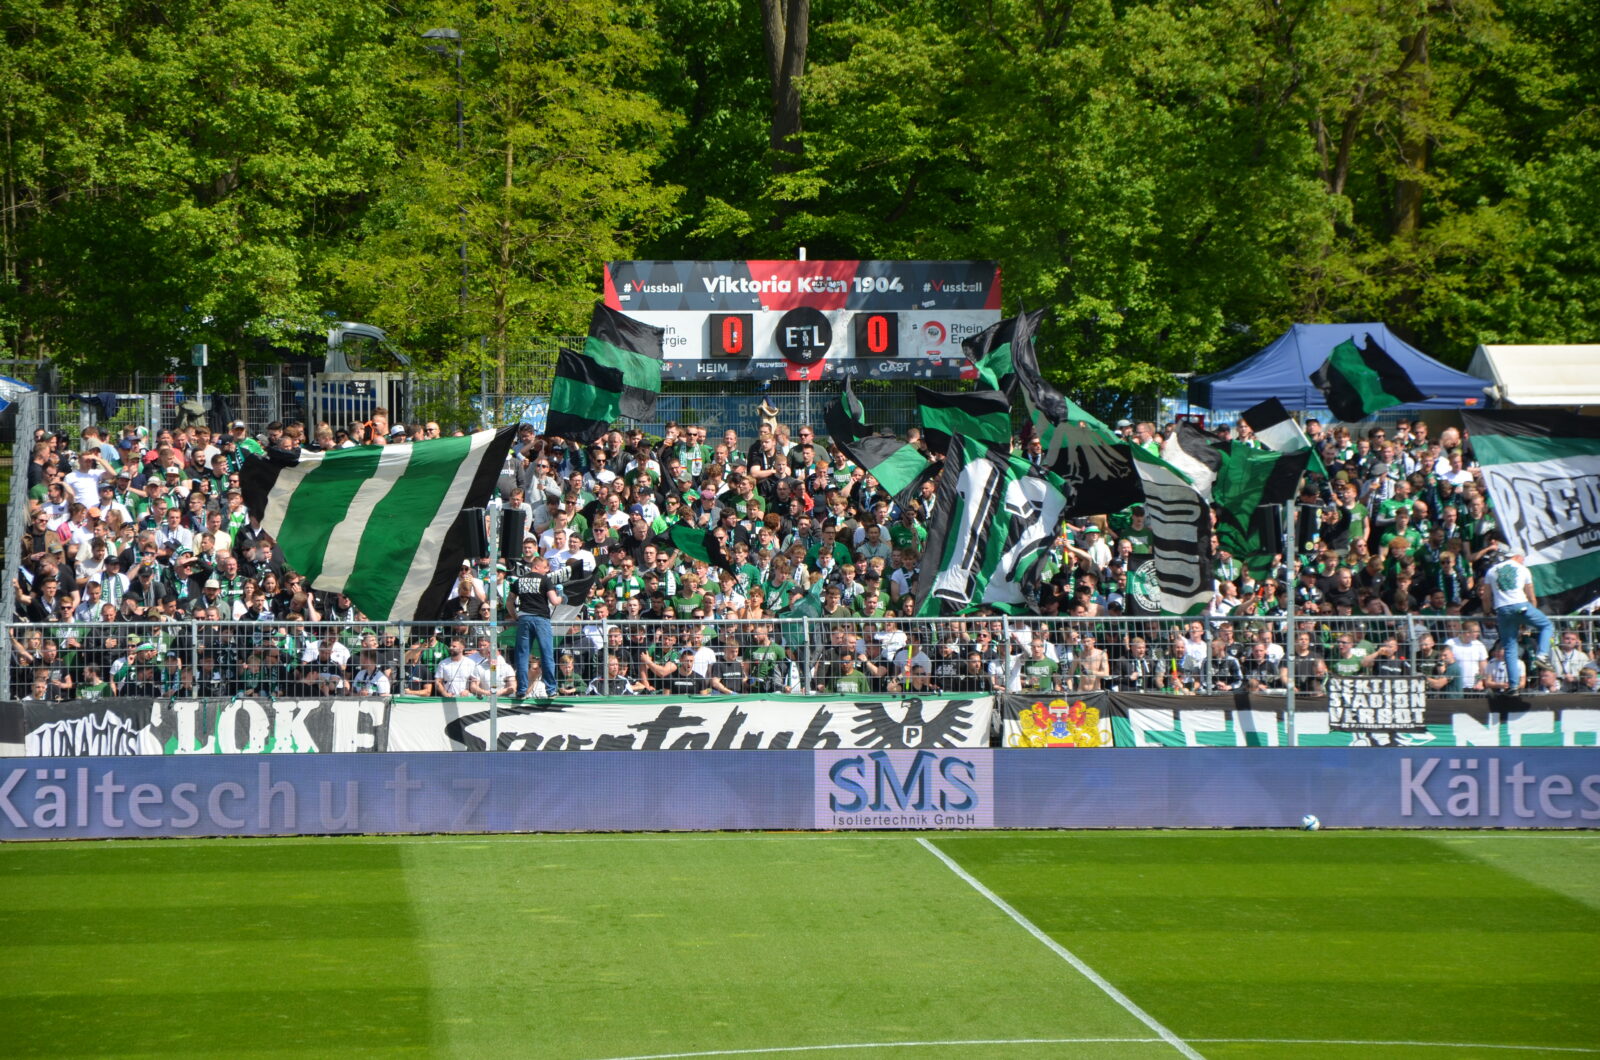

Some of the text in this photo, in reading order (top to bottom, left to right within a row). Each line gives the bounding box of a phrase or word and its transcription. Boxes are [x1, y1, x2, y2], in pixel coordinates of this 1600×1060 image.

[623, 279, 683, 293] #Vussball
[702, 275, 792, 293] Viktoria
[797, 275, 848, 293] Köln
[852, 276, 904, 293] 1904
[722, 316, 743, 354] 0
[867, 315, 888, 353] 0
[950, 323, 983, 334] Rhein
[697, 363, 728, 373] HEIM
[879, 362, 911, 373] GAST
[1329, 678, 1426, 694] SEKTION
[1329, 692, 1426, 708] STADION
[1329, 707, 1426, 724] VERBOT
[905, 727, 919, 744] P
[828, 750, 977, 813] SMS
[1401, 757, 1600, 820] Kältes
[832, 813, 976, 826] Isoliertechnik GmbH
